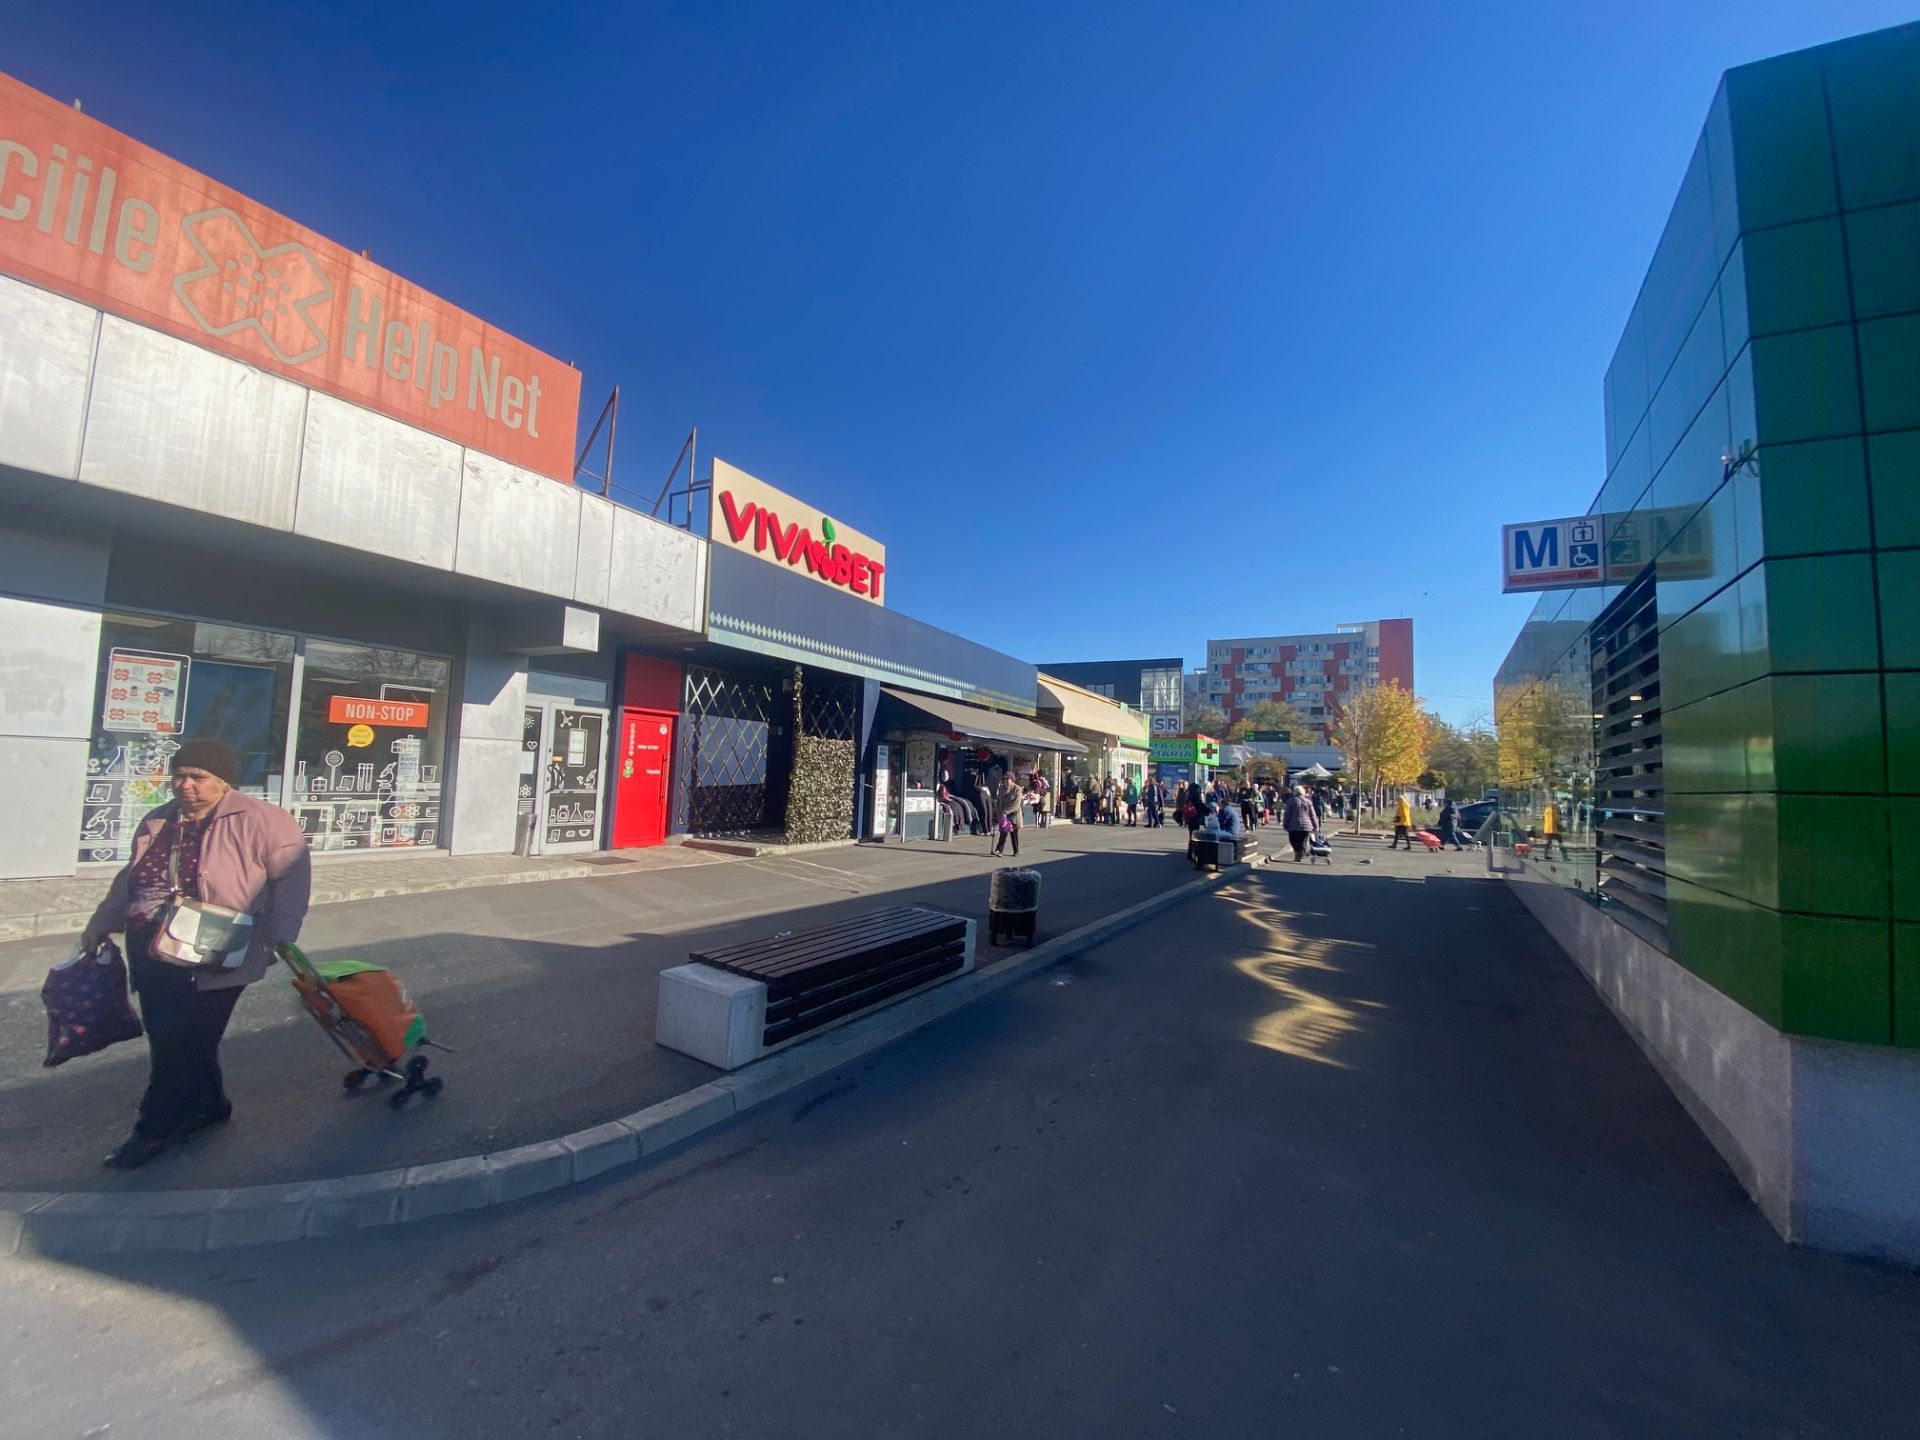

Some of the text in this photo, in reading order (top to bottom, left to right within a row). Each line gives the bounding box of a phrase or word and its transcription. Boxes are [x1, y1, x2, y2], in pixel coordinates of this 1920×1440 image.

[0, 139, 542, 439] ciile Help Net
[1514, 526, 1558, 569] M
[831, 543, 885, 599] BET
[345, 703, 414, 721] NON-STOP
[1149, 717, 1178, 731] SR
